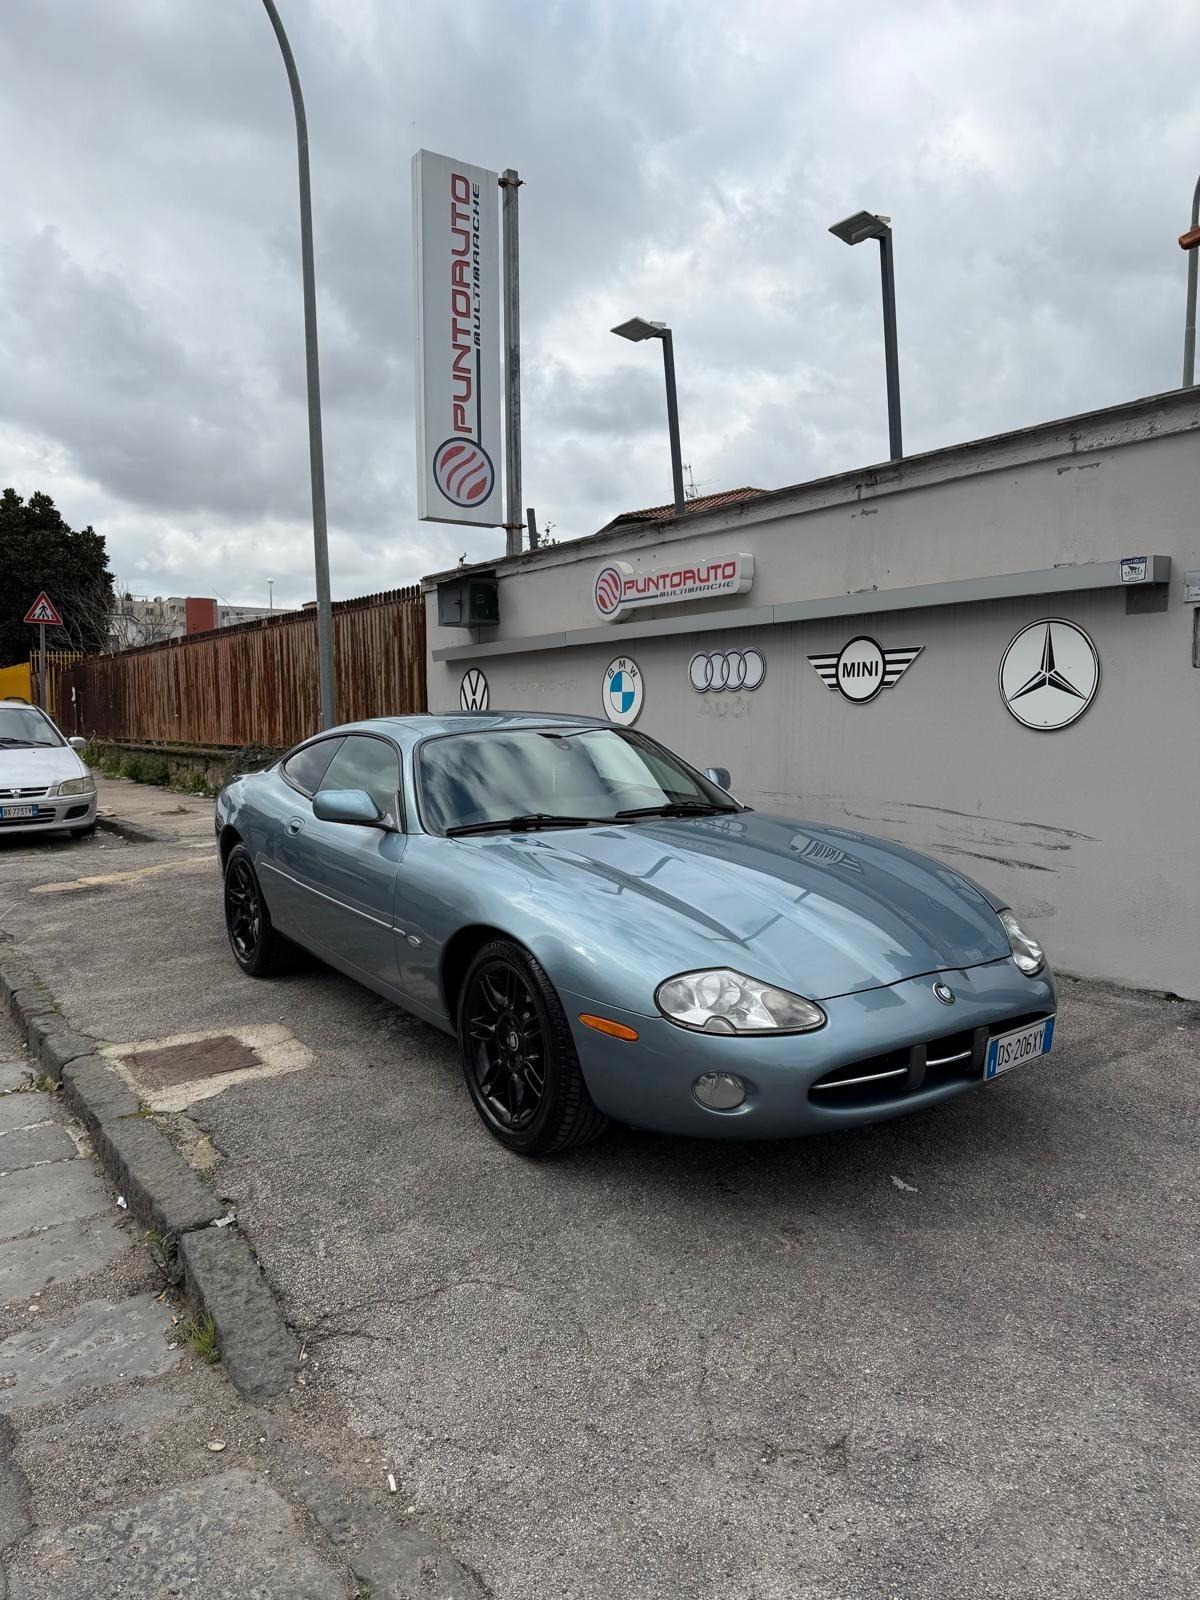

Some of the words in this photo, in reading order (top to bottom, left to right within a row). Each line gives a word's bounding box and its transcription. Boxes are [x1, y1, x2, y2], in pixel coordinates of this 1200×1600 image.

[472, 182, 481, 347] MULTIMARCHE
[451, 173, 472, 433] PUNTOAUTO
[623, 561, 736, 596] PUNTOAUTO
[659, 580, 734, 598] MULTIMARCHE
[607, 659, 638, 680] BMW
[842, 660, 879, 678] MINI
